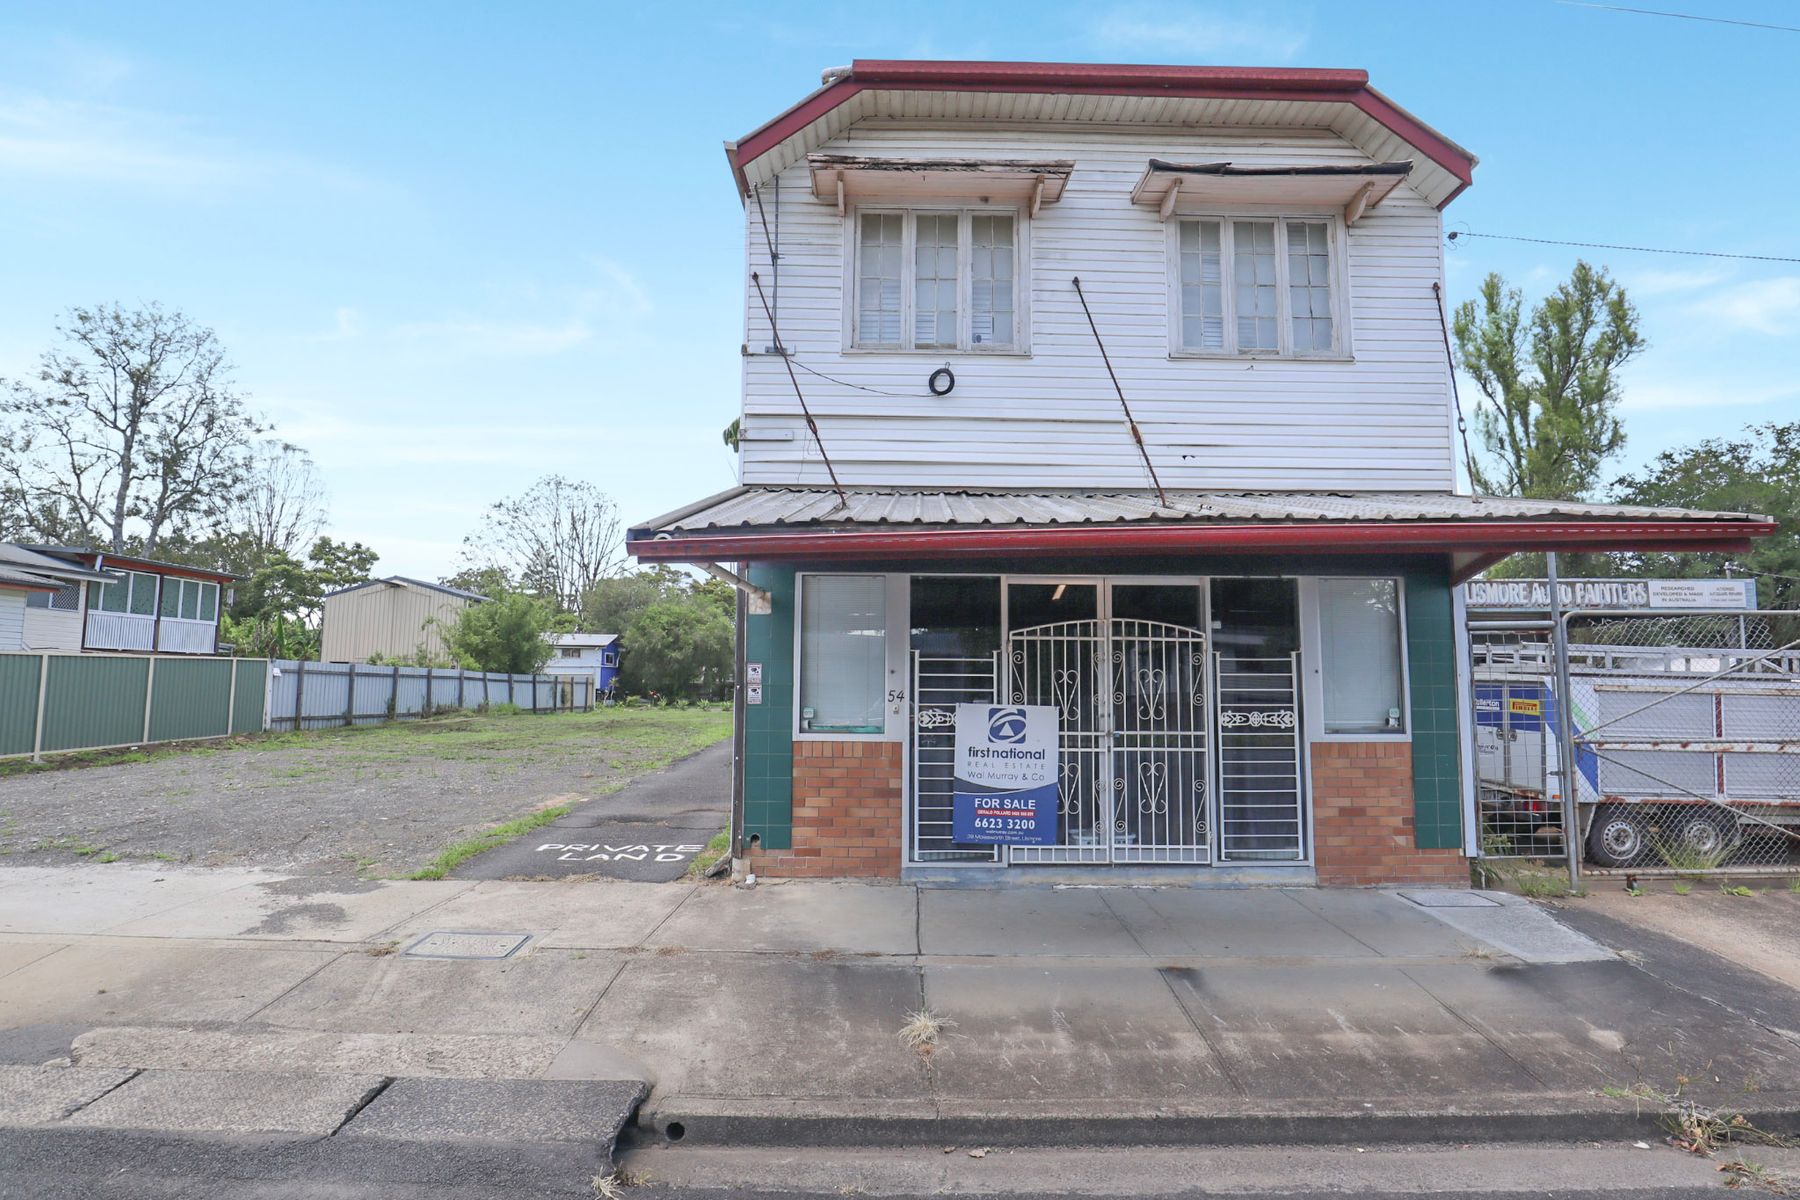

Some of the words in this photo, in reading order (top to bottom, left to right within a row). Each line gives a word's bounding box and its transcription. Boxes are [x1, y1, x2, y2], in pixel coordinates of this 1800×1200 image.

[1465, 582, 1529, 604] LISMORE
[1575, 582, 1648, 605] PAINTERS
[888, 689, 904, 702] 54
[1004, 762, 1046, 770] ESTATE
[967, 771, 985, 779] Wal
[988, 772, 1019, 781] Murray
[1021, 772, 1028, 781] &
[1031, 773, 1045, 781] Co
[975, 798, 1000, 808] FOR
[1004, 799, 1036, 809] SALE
[974, 818, 1002, 828] 6623
[1007, 819, 1036, 829] 3200
[535, 843, 705, 852] PRIVATE
[556, 852, 686, 862] LAND
